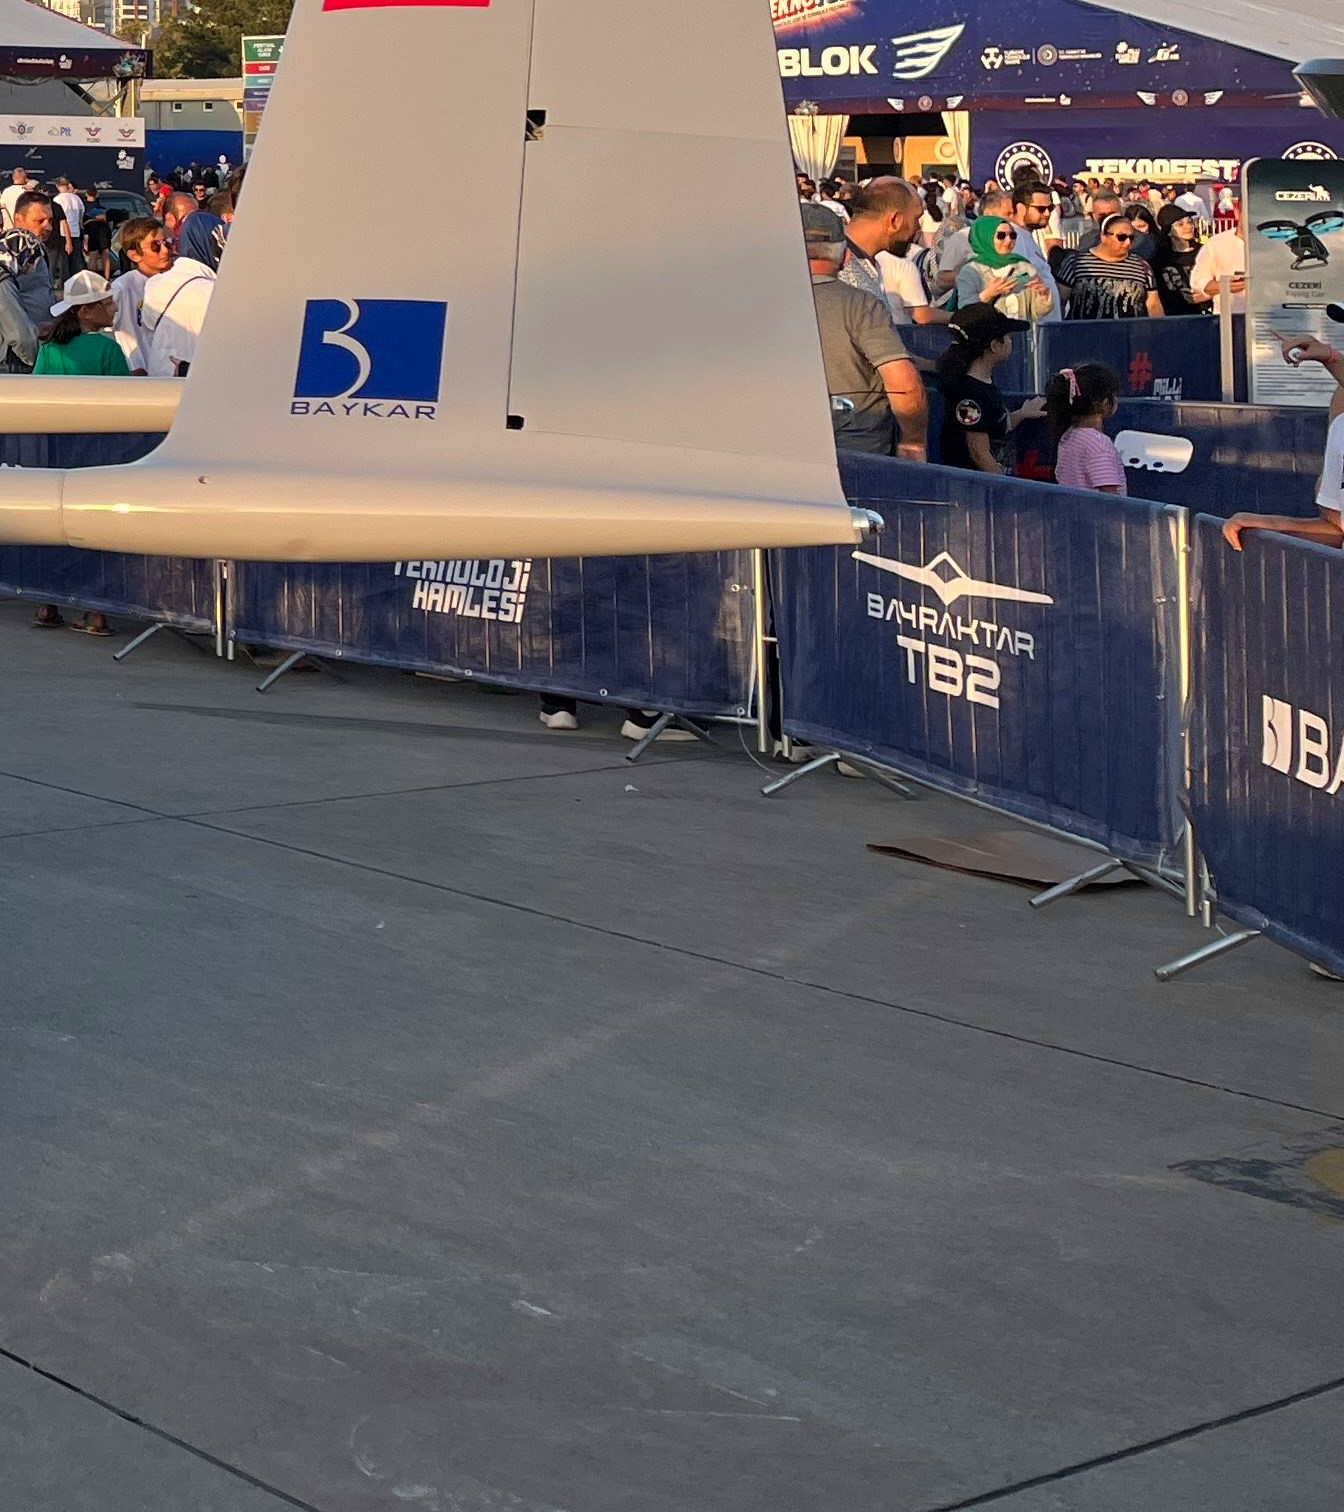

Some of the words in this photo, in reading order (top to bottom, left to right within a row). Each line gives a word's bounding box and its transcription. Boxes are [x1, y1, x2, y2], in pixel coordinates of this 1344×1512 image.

[777, 44, 879, 78] BLOK
[1288, 280, 1322, 290] CEZERİ
[290, 401, 436, 420] BAYKAR
[412, 579, 527, 624] HAMLESİ
[867, 592, 1035, 660] BAYRAKTAR
[897, 634, 1001, 710] TB2
